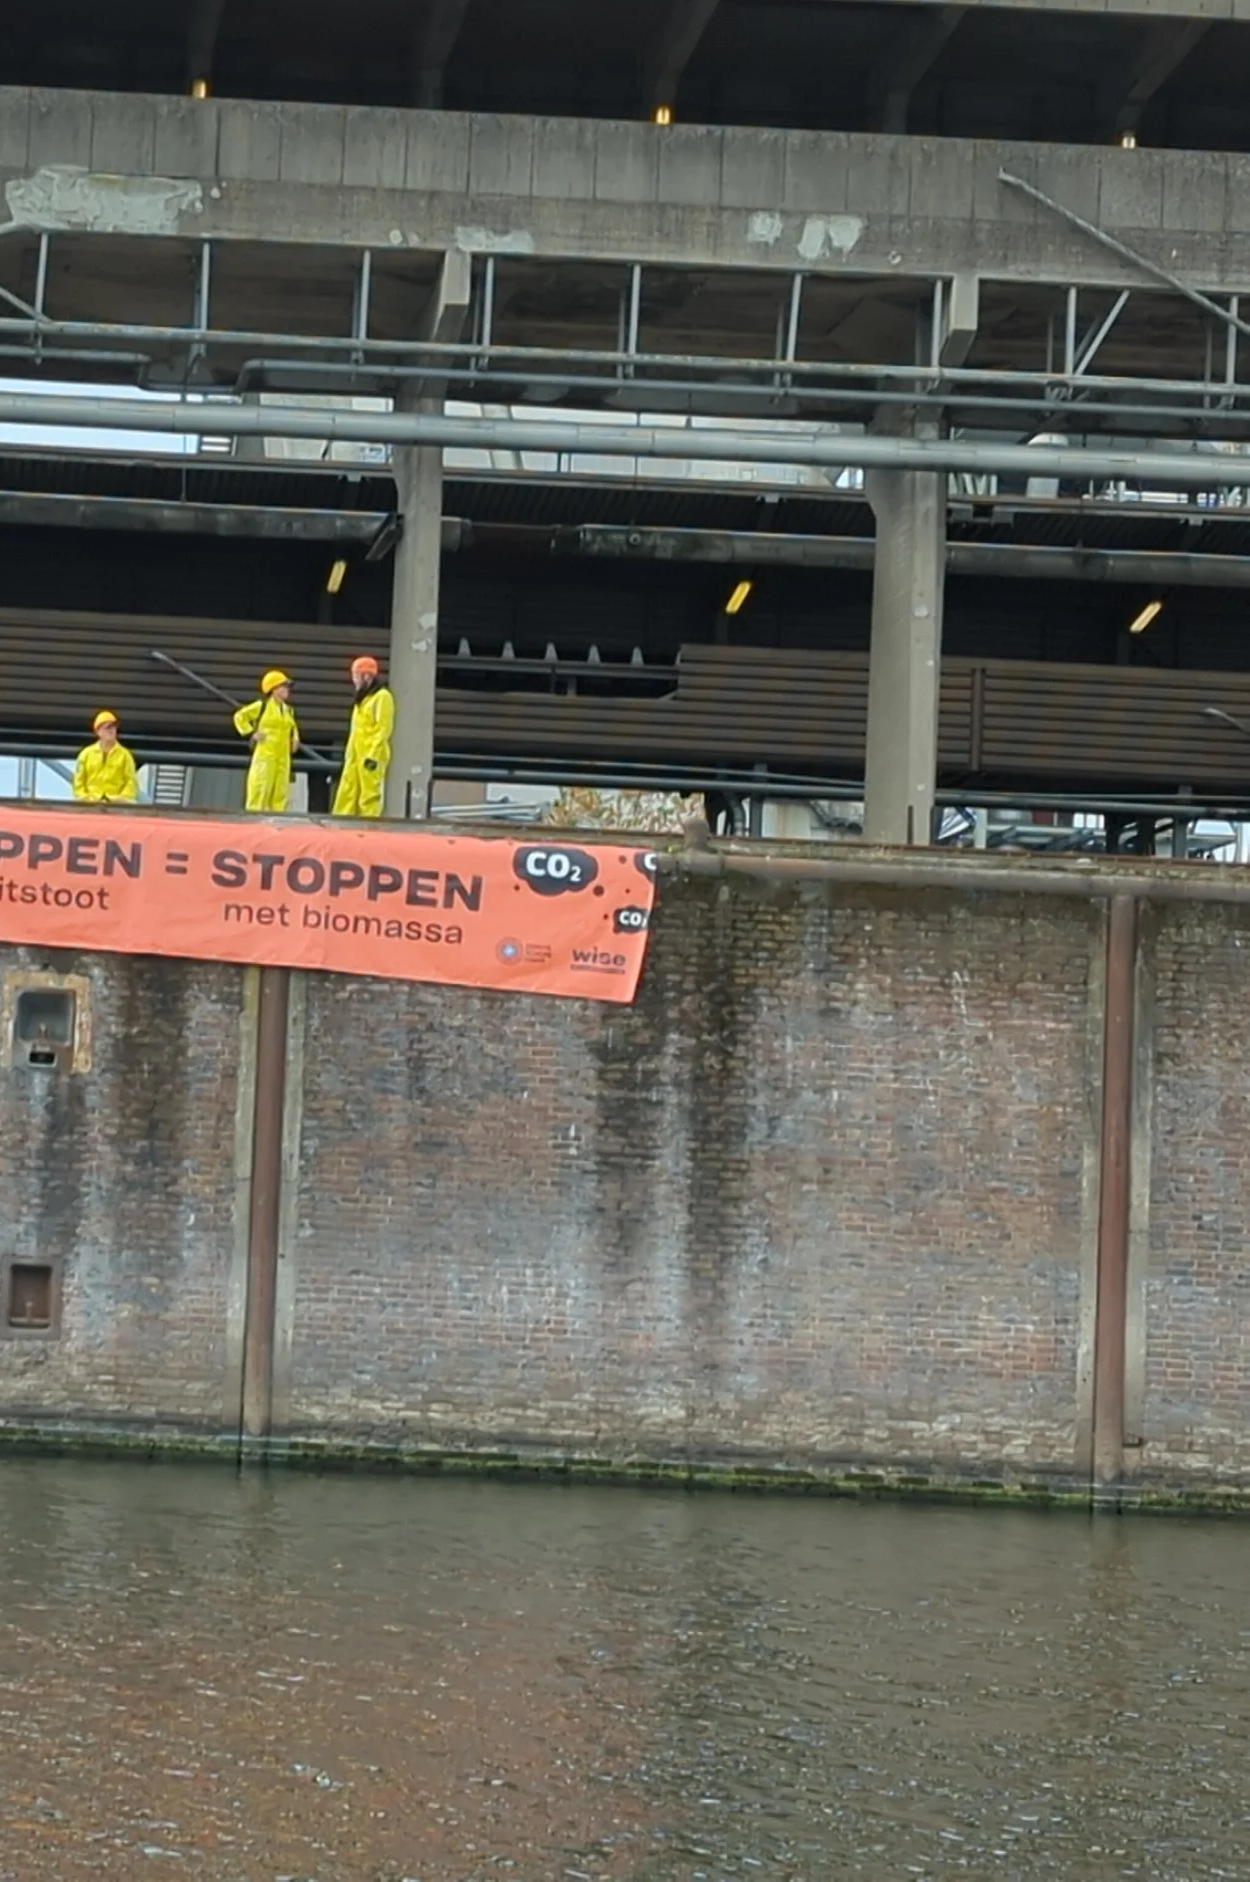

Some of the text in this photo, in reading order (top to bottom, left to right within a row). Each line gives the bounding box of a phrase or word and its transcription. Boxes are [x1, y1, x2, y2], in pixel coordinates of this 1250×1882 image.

[211, 850, 483, 911] STOPPEN
[223, 902, 463, 945] met biomassa
